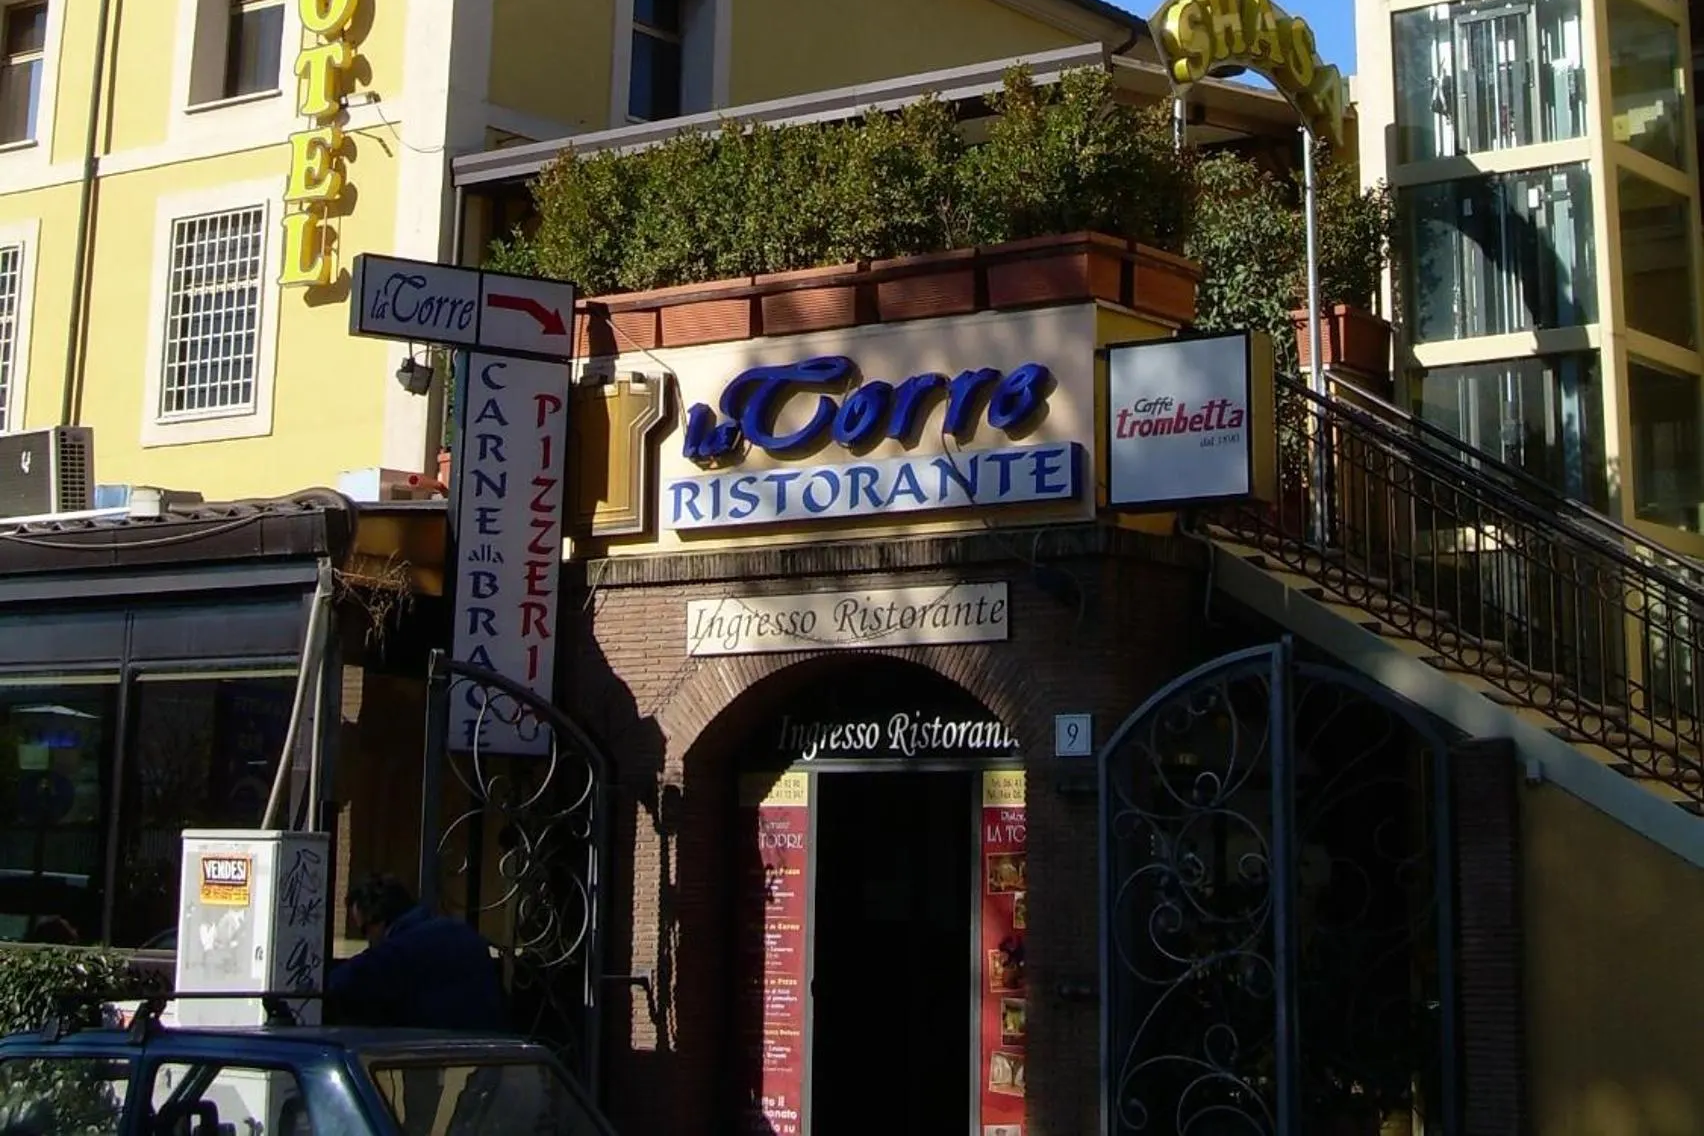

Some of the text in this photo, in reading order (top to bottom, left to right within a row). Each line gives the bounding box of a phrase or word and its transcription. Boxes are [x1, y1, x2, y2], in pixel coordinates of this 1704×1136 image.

[370, 272, 476, 330] la Torre
[719, 356, 1056, 452] Torre
[1116, 399, 1244, 439] trombetta
[472, 362, 508, 535] CARNE
[667, 449, 1066, 522] RISTORANTE
[467, 547, 505, 564] alla
[690, 597, 1006, 650] Ingresso Ristorante
[778, 714, 880, 761] Ingresso
[1067, 723, 1079, 751] 9
[987, 825, 1002, 843] LA
[203, 860, 247, 880] VENDESI
